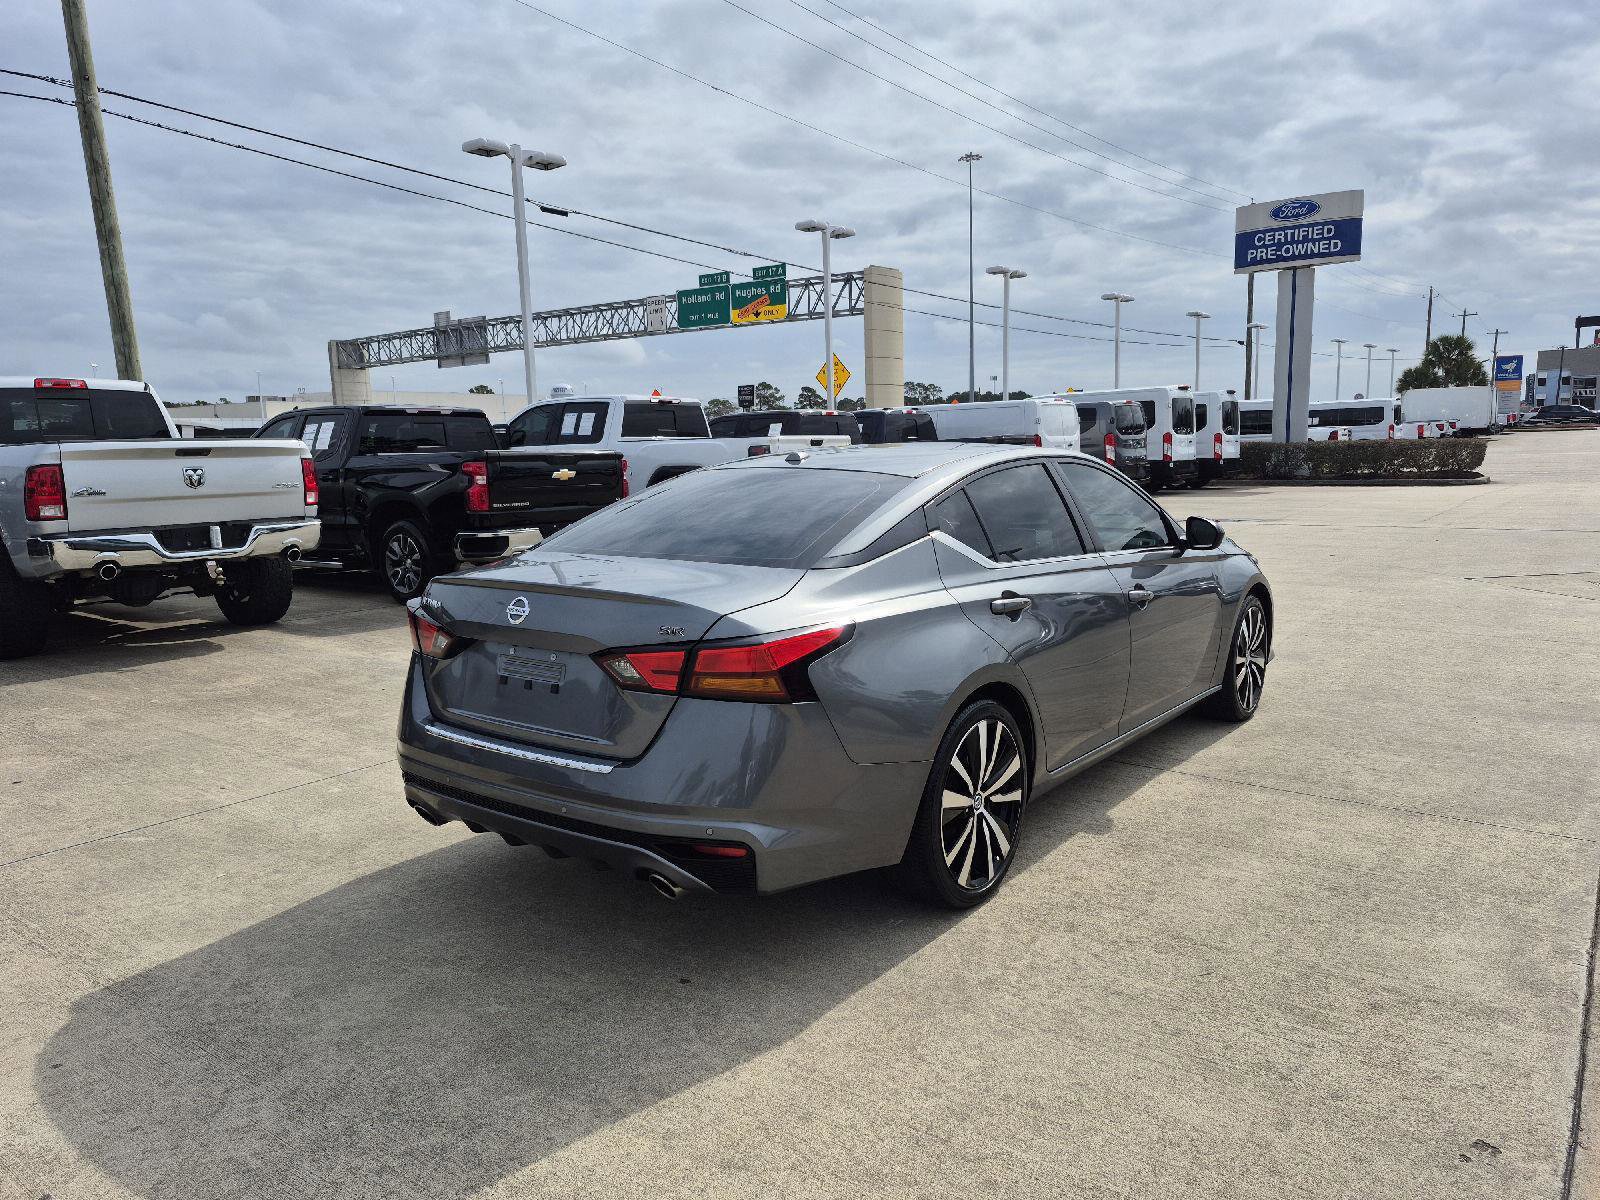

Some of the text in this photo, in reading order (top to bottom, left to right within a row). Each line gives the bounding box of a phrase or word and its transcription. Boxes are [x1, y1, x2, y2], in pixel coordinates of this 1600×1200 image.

[1279, 203, 1308, 217] Ford
[1254, 224, 1335, 246] CERTIFIED
[1247, 239, 1342, 262] PRE-OWNED
[682, 291, 725, 304] Holland Rd
[735, 284, 781, 299] Hughes Rd
[647, 299, 665, 307] SPEED
[763, 309, 780, 317] ONLY
